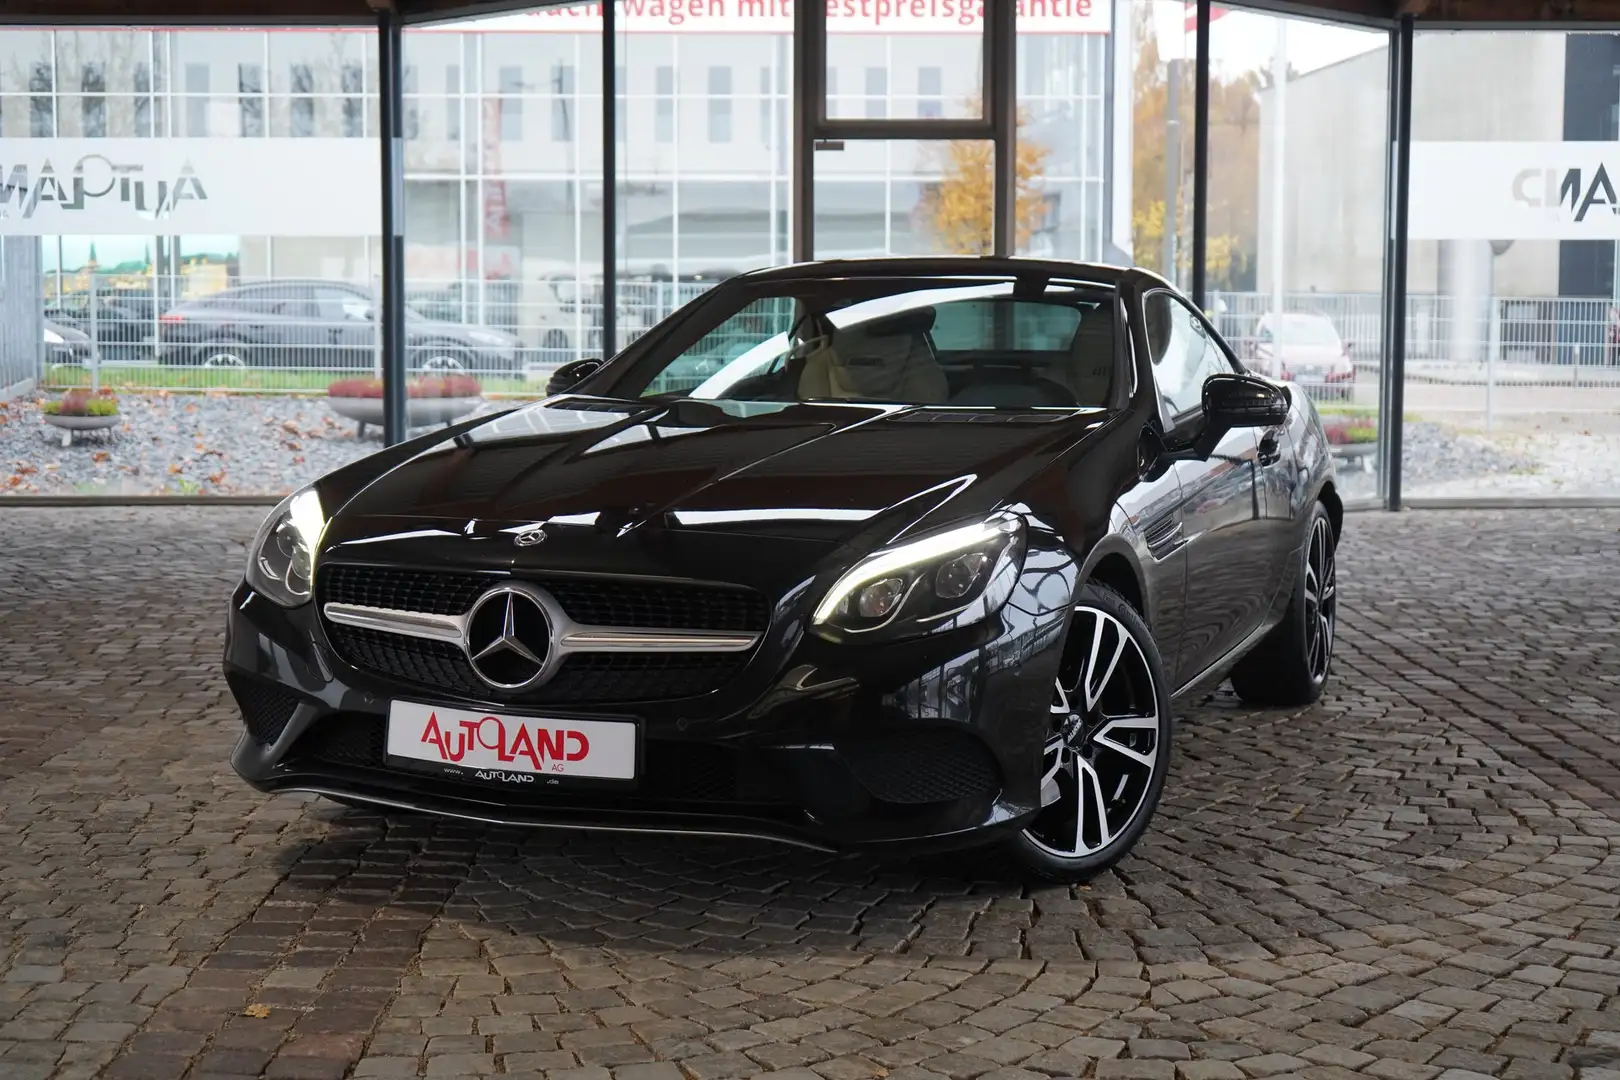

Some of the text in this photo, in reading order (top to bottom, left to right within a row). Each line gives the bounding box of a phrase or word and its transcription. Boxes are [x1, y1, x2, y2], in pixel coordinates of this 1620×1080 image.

[421, 711, 589, 771] AUTOLAND
[551, 764, 564, 772] AG
[475, 770, 534, 783] AUTOLAND
